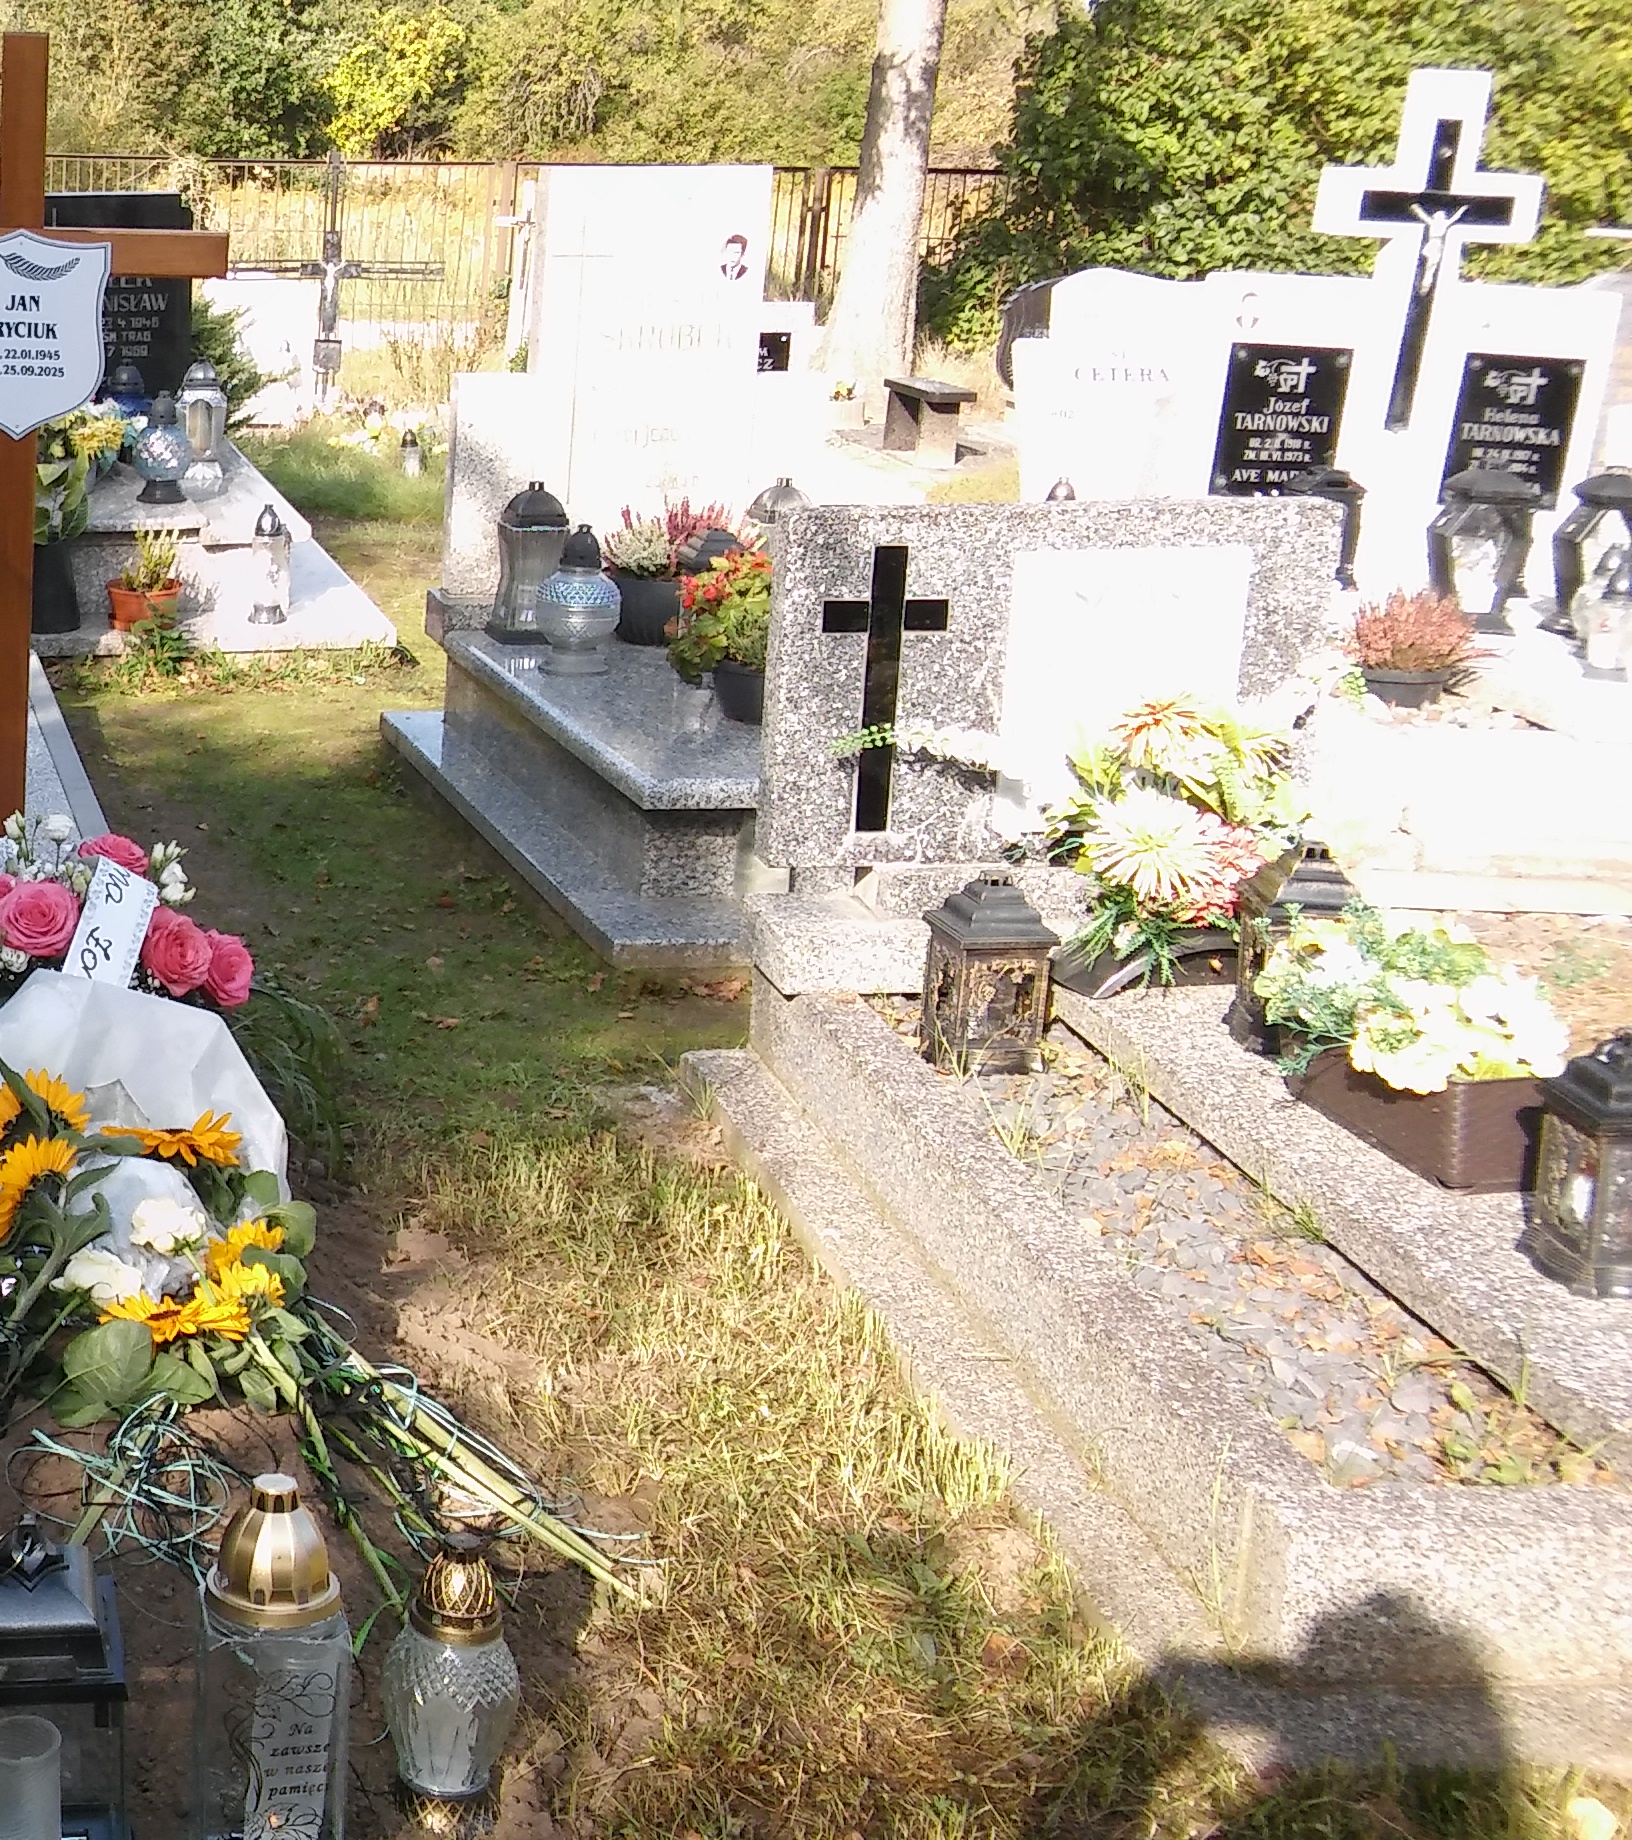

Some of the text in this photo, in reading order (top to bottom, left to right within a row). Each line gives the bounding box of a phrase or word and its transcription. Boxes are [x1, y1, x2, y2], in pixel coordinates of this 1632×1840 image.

[4, 294, 40, 312] JAN
[1074, 367, 1170, 382] CETERA
[1263, 396, 1311, 415] Józef
[1234, 412, 1330, 434] TARNOWSKI
[1460, 422, 1560, 446] TARNOWSKA
[1231, 468, 1261, 483] AVE
[288, 1722, 313, 1737] Na
[264, 1767, 279, 1778] w
